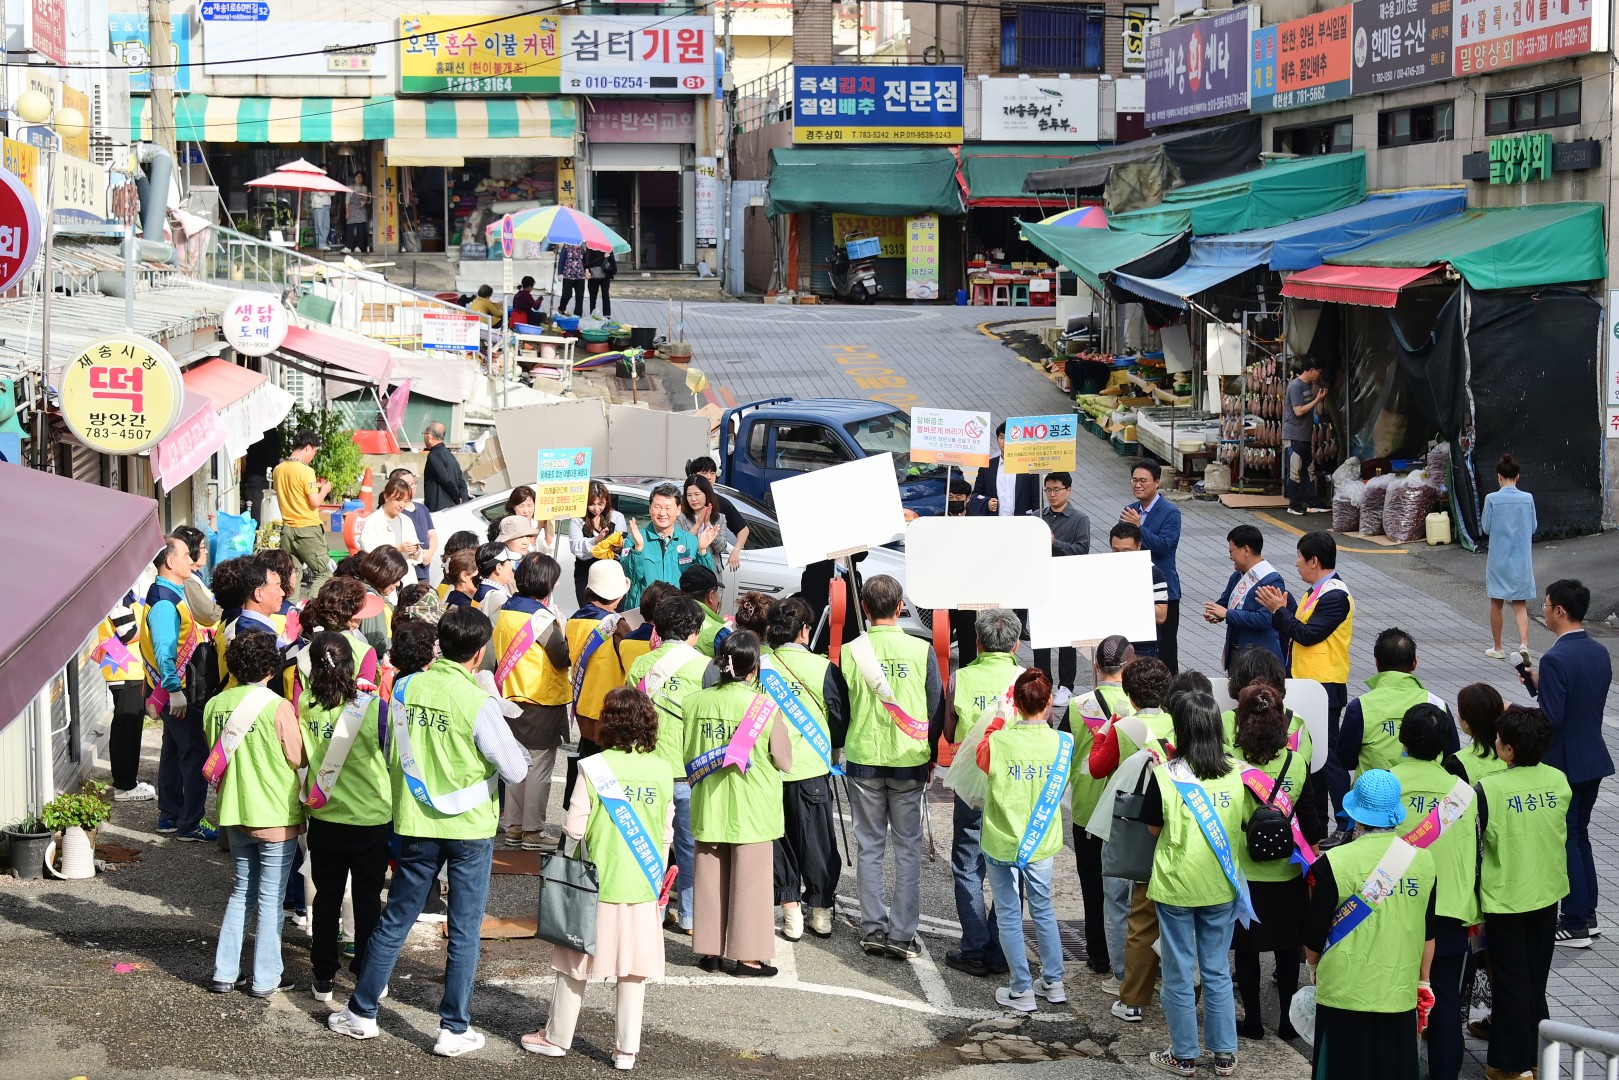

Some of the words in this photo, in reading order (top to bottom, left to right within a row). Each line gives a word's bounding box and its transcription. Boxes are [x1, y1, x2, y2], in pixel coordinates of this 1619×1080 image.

[203, 7, 213, 15] 28
[213, 2, 258, 14] 재송1로60번길
[258, 7, 268, 15] 32
[406, 33, 440, 57] 오복
[444, 32, 478, 56] 혼수
[484, 32, 518, 56] 이불
[523, 32, 556, 56] 커텐
[571, 30, 634, 61] 쉼터
[642, 29, 704, 63] 기원
[1404, 18, 1427, 55] 수산
[1460, 38, 1514, 72] 밀양상회
[436, 61, 465, 75] 홈패션
[883, 80, 958, 113] 전문점
[621, 112, 696, 132] 반석교회
[1038, 118, 1071, 131] 손두부
[806, 130, 843, 140] 경주상회
[1489, 134, 1547, 185] 밀양상회
[234, 304, 275, 323] 생닭
[238, 324, 270, 339] 도매
[89, 366, 143, 413] 떡
[89, 412, 147, 428] 방앗간
[85, 427, 152, 440] 783-4507
[1050, 424, 1071, 437] 꽁초
[1507, 791, 1558, 813] 재송1동
